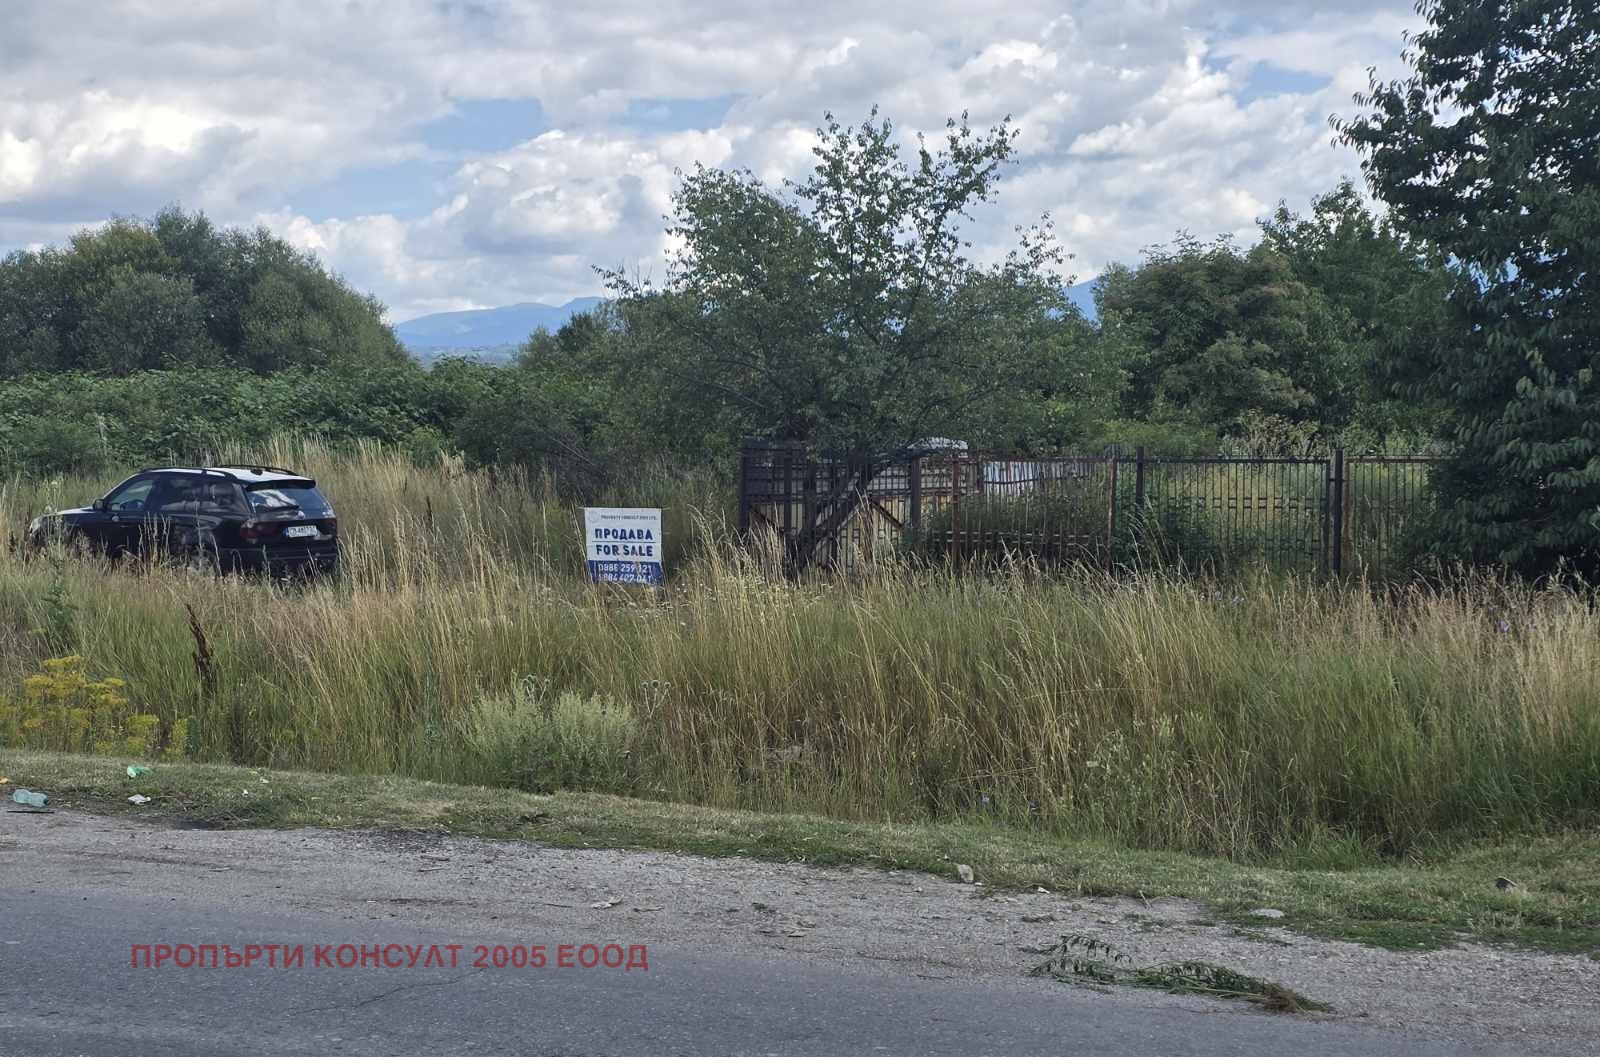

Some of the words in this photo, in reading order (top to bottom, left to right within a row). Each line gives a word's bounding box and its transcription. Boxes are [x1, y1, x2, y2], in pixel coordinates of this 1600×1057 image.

[594, 528, 653, 540] ПРОДАВА
[596, 544, 620, 556] FOR
[622, 545, 653, 557] SALE
